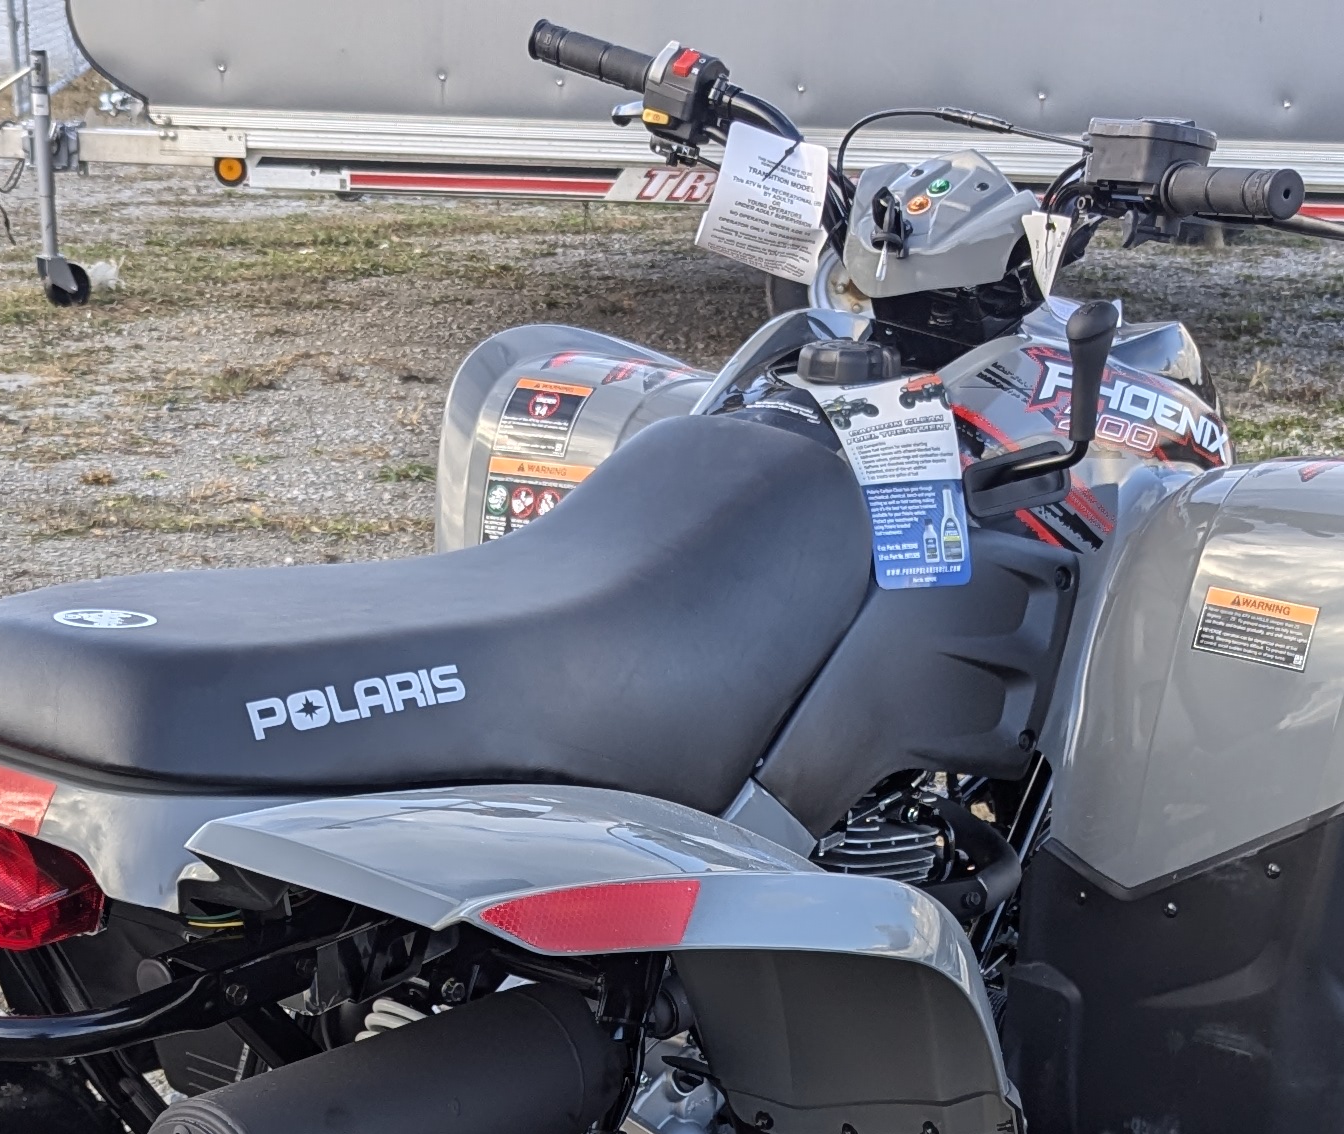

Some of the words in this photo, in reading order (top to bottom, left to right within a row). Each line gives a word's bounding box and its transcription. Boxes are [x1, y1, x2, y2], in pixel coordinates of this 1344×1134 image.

[790, 181, 815, 193] MODEL
[1038, 360, 1228, 465] PHOENIX
[527, 465, 567, 476] WARNING
[1242, 597, 1291, 615] WARNING
[245, 664, 466, 741] POLARIS
